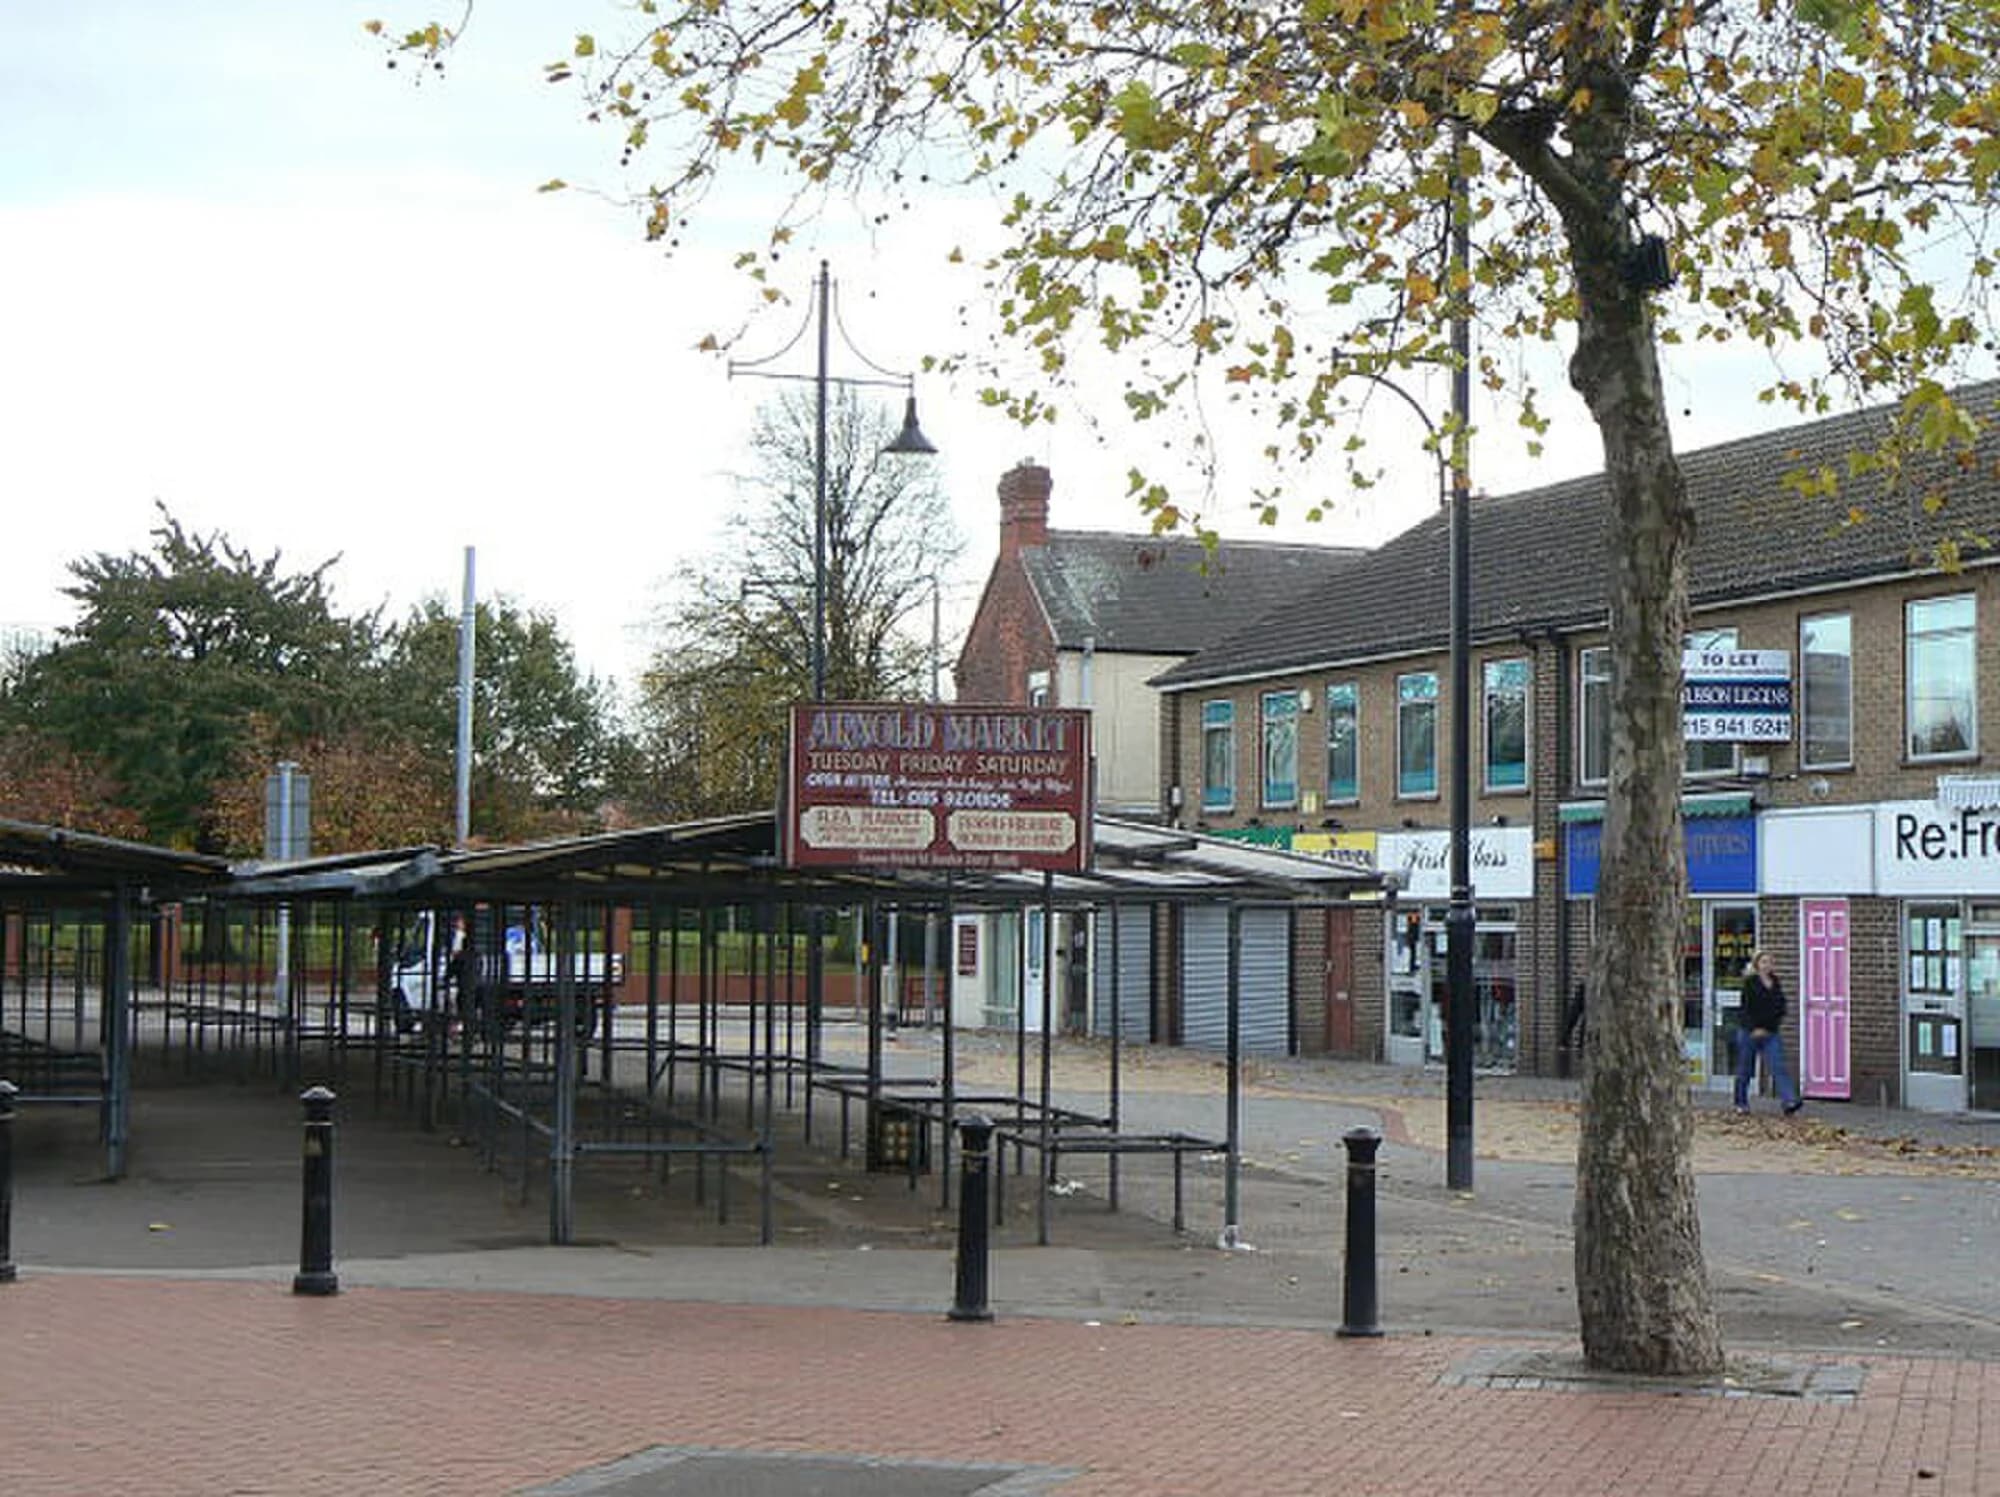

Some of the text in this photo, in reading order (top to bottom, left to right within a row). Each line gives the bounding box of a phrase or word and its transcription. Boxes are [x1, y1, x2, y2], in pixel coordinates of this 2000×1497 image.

[1701, 653, 1758, 666] TO LET
[807, 711, 1068, 752] ARNOLD MARKET
[1714, 719, 1745, 735] 941
[808, 751, 1069, 775] TUESDAY FRIDAY SATURDAY
